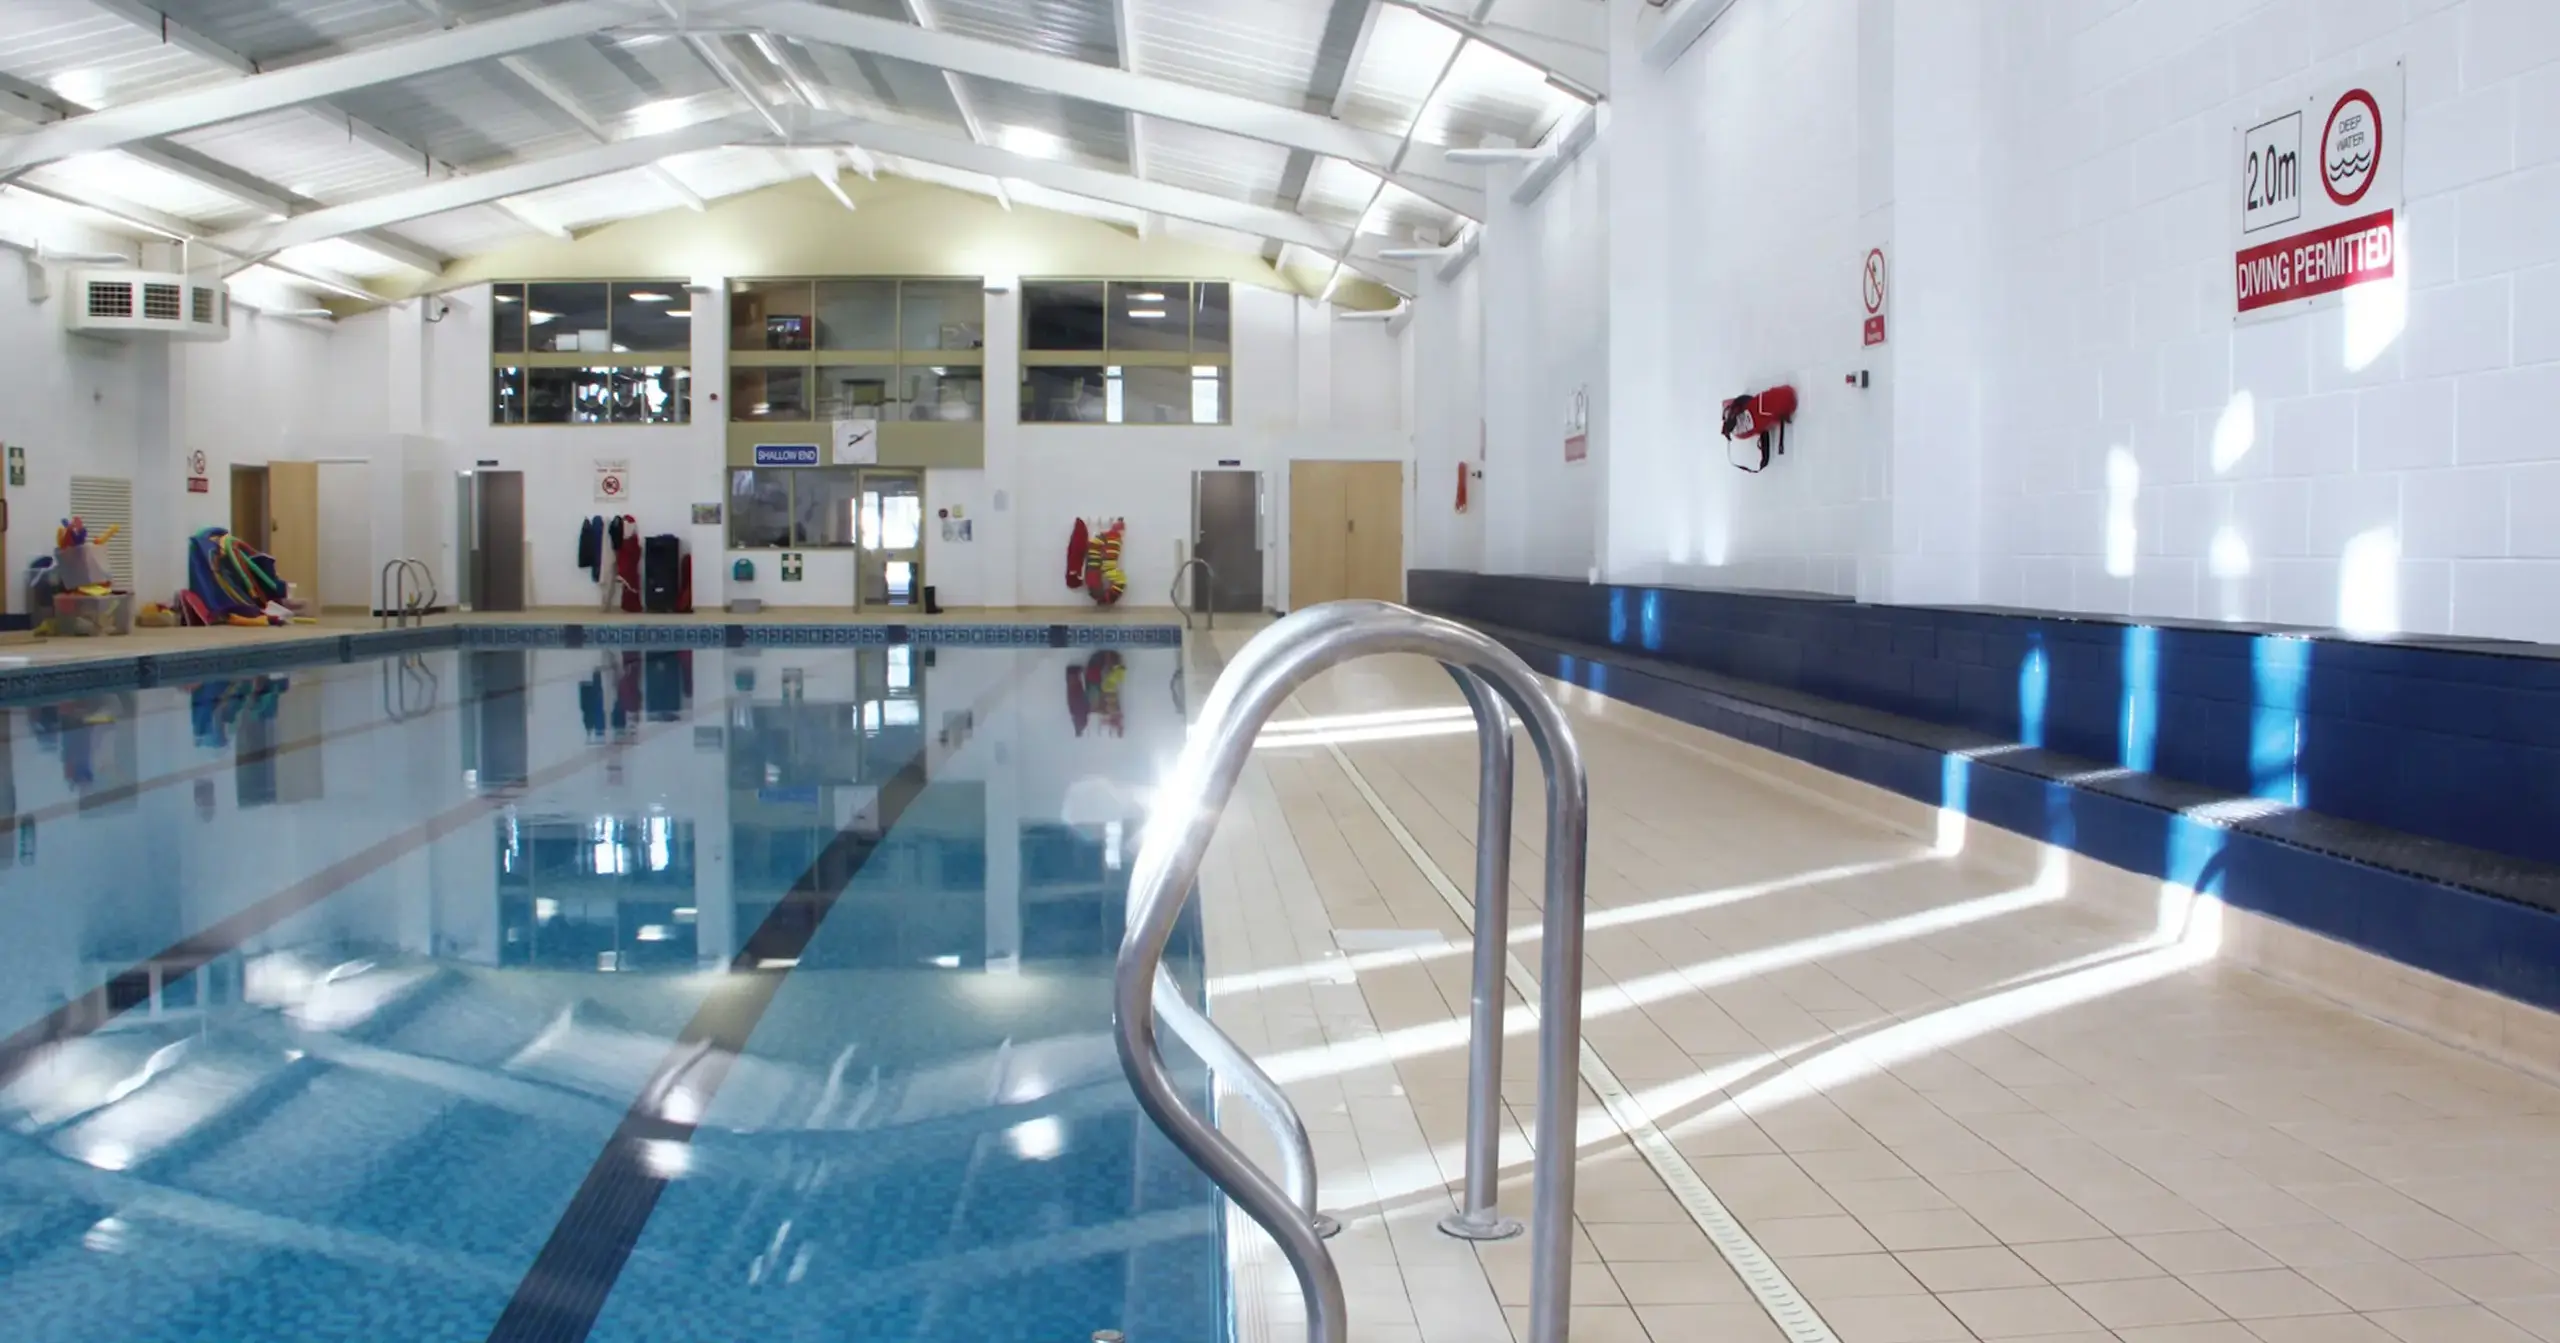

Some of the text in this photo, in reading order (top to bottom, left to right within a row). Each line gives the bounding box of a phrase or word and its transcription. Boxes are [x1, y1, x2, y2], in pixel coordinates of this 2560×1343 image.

[2339, 114, 2362, 134] DEEP
[2336, 131, 2365, 152] WATER
[2247, 144, 2297, 211] 2.0m
[2238, 224, 2392, 300] DIVING PERMITTED
[758, 450, 816, 461] SHALLOW END
